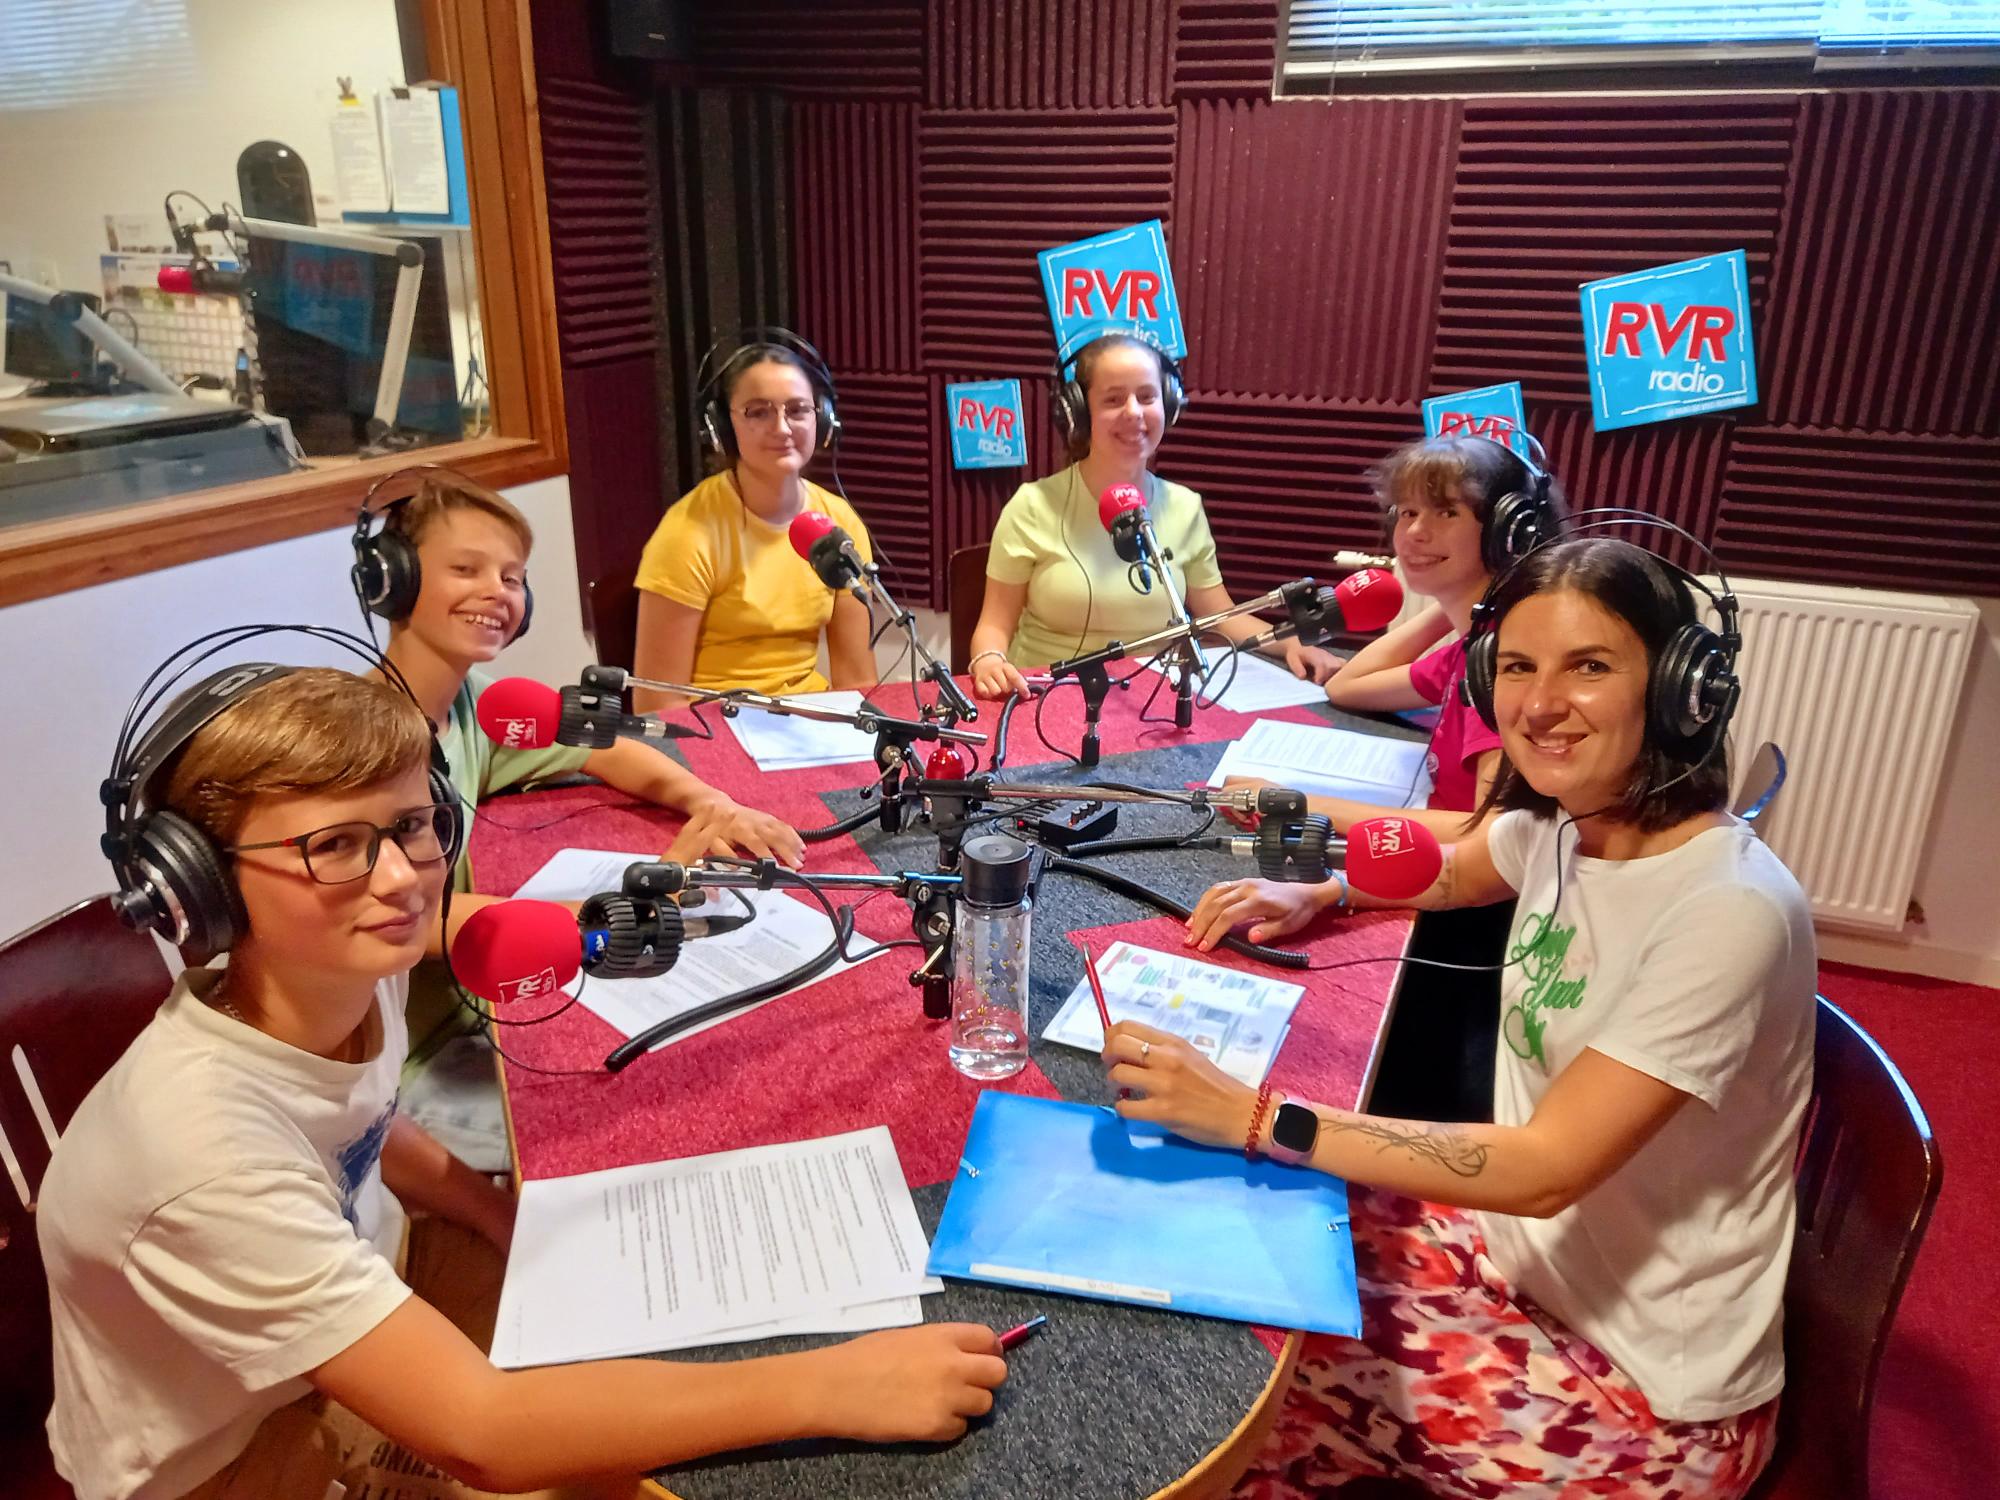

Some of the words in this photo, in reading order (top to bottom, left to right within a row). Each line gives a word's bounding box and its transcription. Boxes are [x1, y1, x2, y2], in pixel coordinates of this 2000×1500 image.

[1062, 268, 1160, 319] RVR
[1602, 302, 1736, 362] RVR
[1649, 362, 1724, 394] radio
[958, 398, 1016, 439] RVR
[978, 438, 1012, 457] radio
[1381, 820, 1403, 851] RVR
